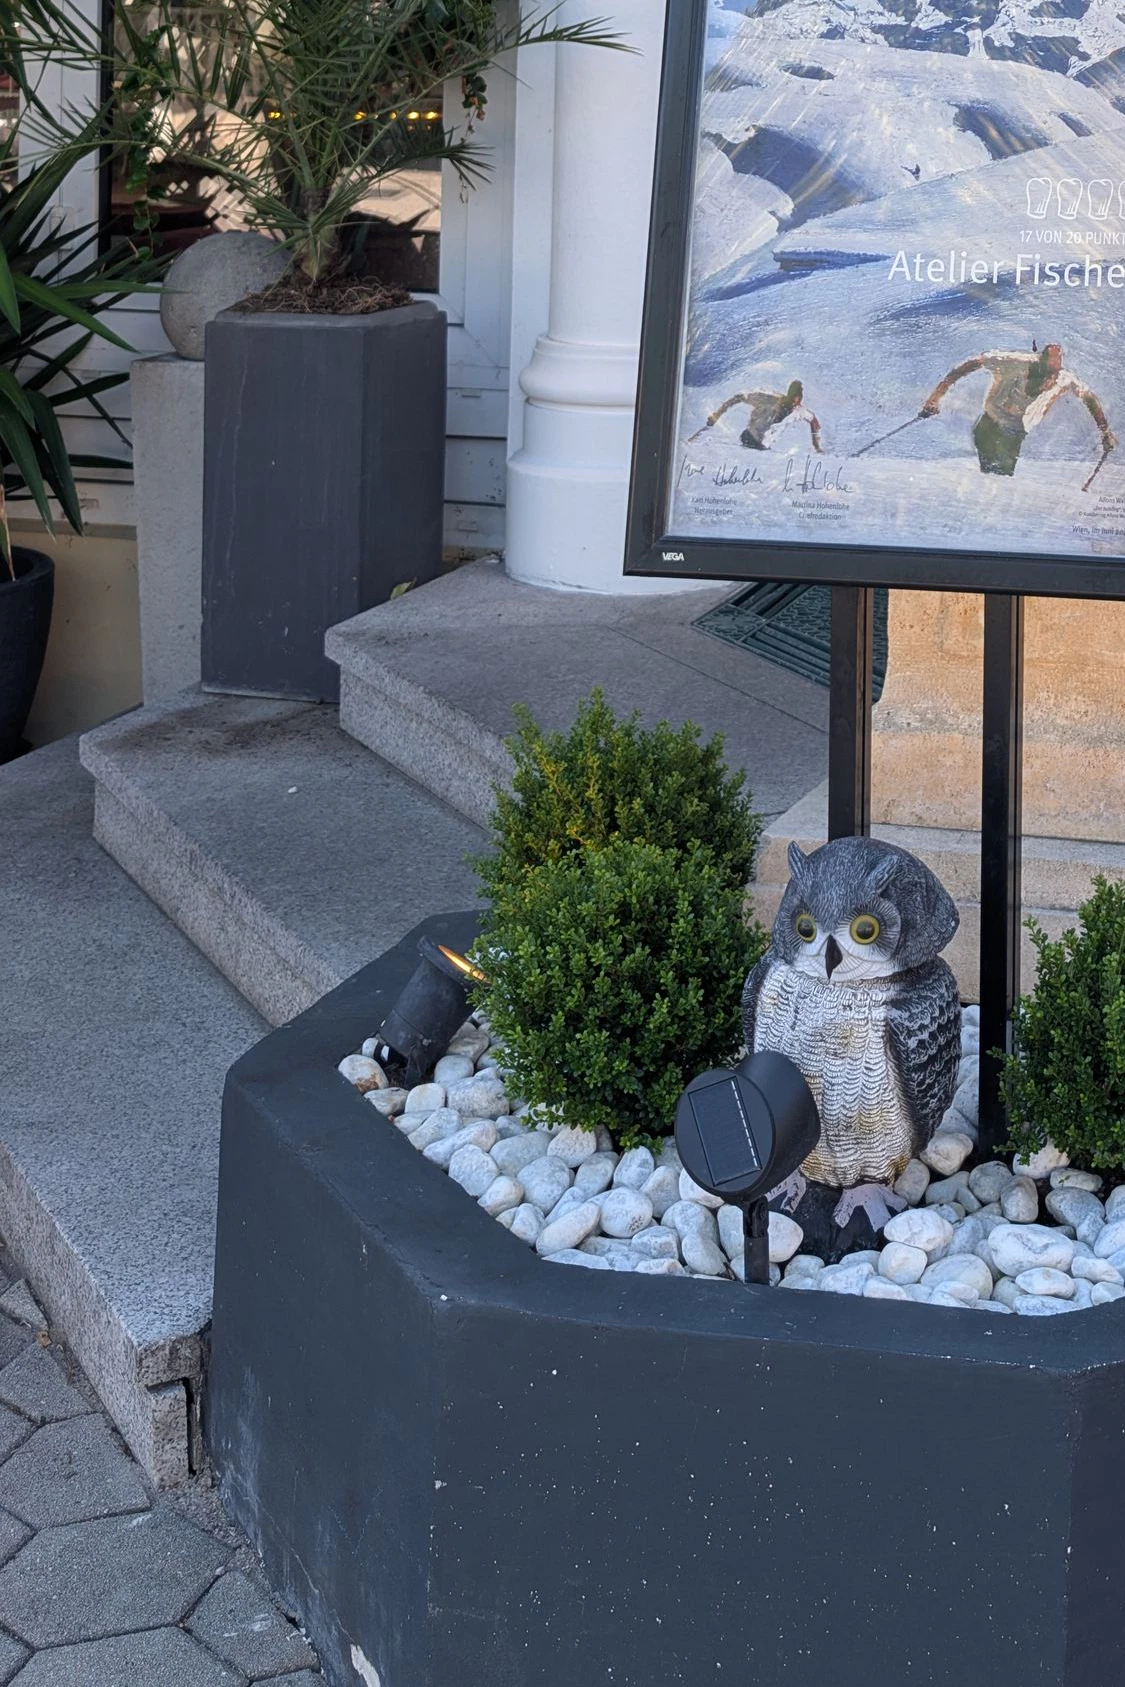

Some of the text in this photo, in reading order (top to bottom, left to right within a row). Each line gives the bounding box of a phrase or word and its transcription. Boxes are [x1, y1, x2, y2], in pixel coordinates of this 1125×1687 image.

[1019, 230, 1032, 243] 17
[1036, 230, 1062, 244] VON
[1066, 231, 1082, 244] 20
[887, 250, 1002, 285] Atelier
[791, 500, 850, 511] Martina Hohenlohe
[1072, 525, 1090, 534] Wien,
[662, 552, 685, 562] VEGA
